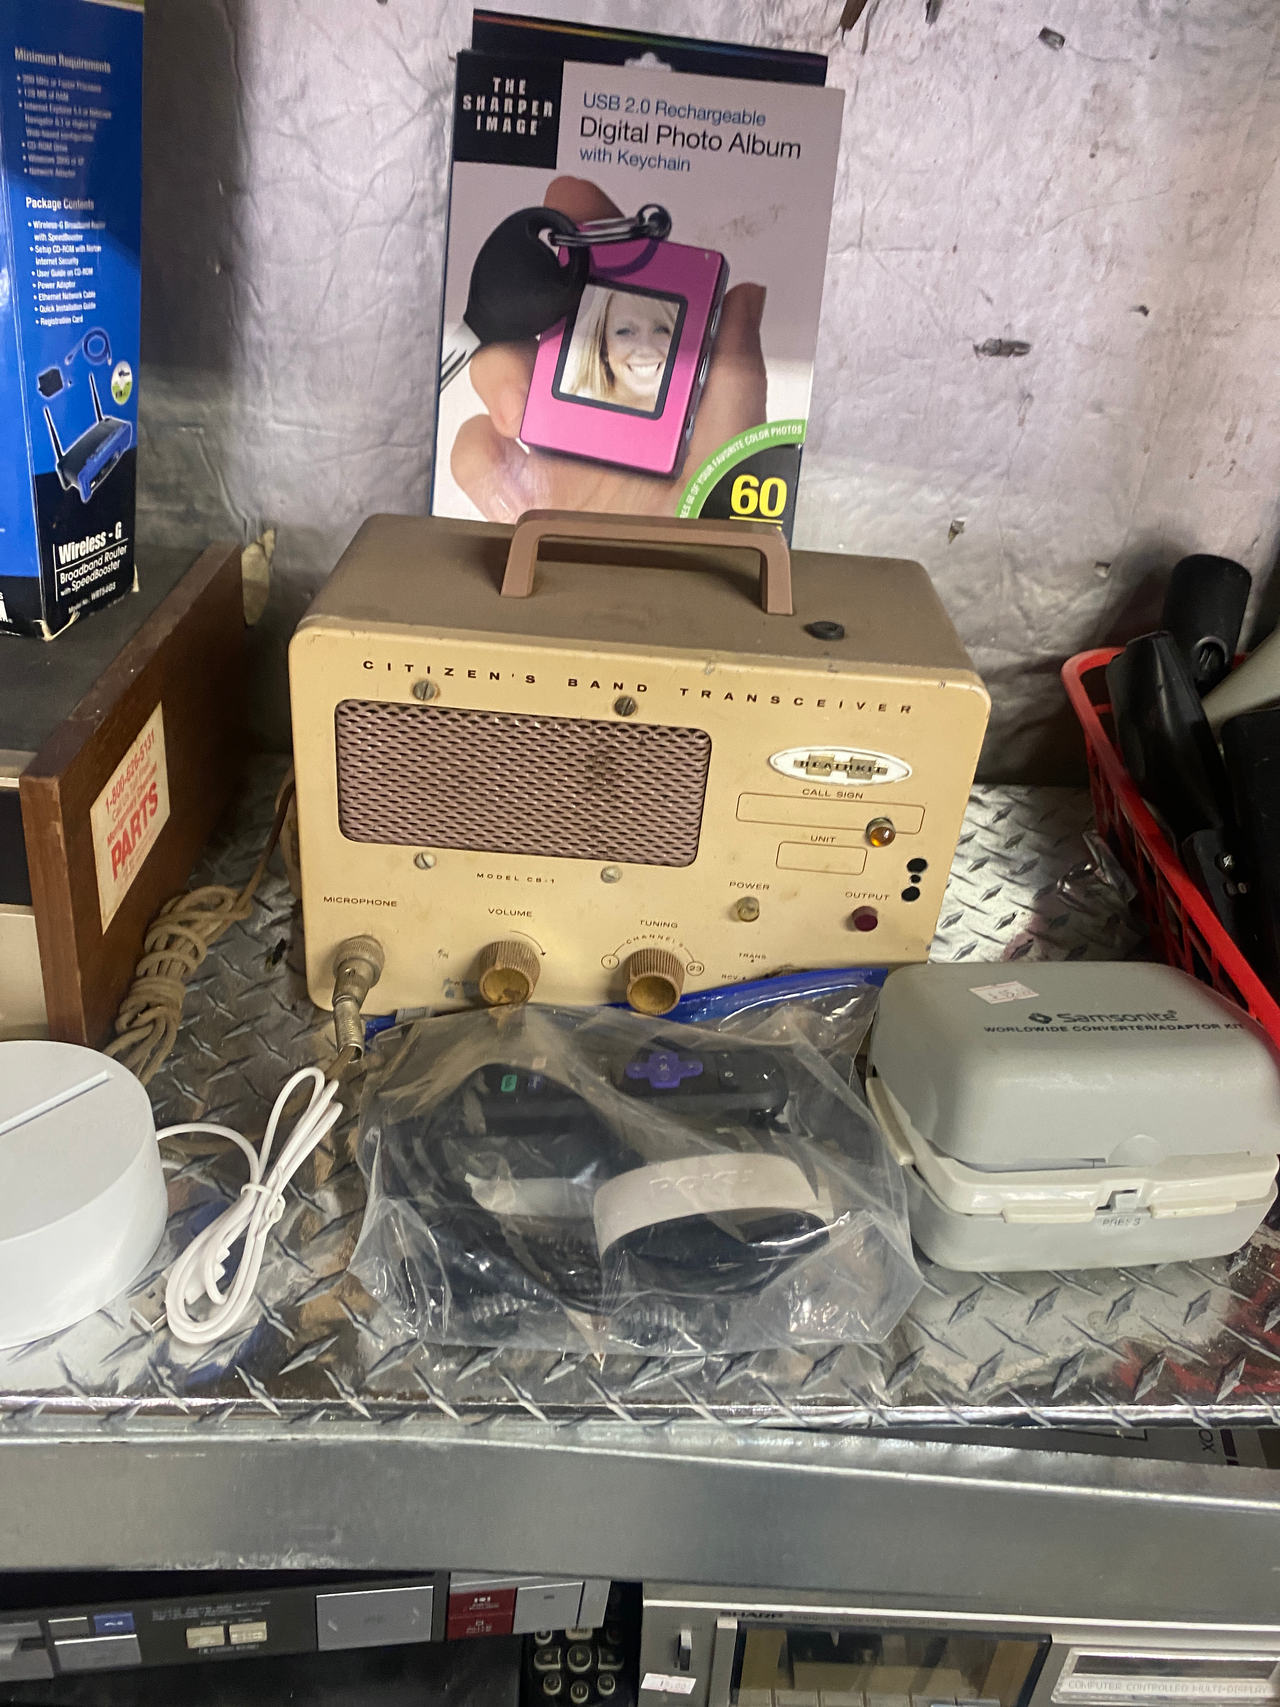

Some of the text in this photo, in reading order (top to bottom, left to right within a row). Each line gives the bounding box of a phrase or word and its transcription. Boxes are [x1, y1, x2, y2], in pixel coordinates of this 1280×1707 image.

[14, 46, 57, 66] Minimum
[492, 77, 526, 95] THE
[462, 95, 553, 117] SHARPER
[583, 92, 766, 126] USB 2.0 Rechargeable
[476, 115, 538, 135] IMAGE
[579, 116, 801, 159] Digital Photo Album
[579, 147, 690, 172] with Keychain
[25, 196, 95, 212] Package Contents
[744, 430, 770, 446] COLOR
[770, 424, 803, 436] PHOTOS
[730, 474, 788, 518] 60
[58, 531, 107, 565] Wireless
[115, 521, 122, 540] G
[60, 544, 127, 584] Broadband Router
[71, 559, 121, 592] SpeedBooster
[363, 660, 912, 714] CITIZEN'S BAND TRANSCEIVER
[802, 788, 864, 799] CALL SIGN
[110, 781, 159, 881] PARTS
[810, 835, 836, 844] UNIT
[476, 872, 520, 882] MODEL
[729, 881, 770, 891] POWER
[323, 896, 398, 907] MICROPHONE
[845, 891, 890, 900] OUTPUT
[488, 908, 534, 918] VOLUME
[640, 919, 679, 929] TUNING
[1056, 1010, 1173, 1023] Samsonite
[984, 1025, 1068, 1033] WORLDWIDE
